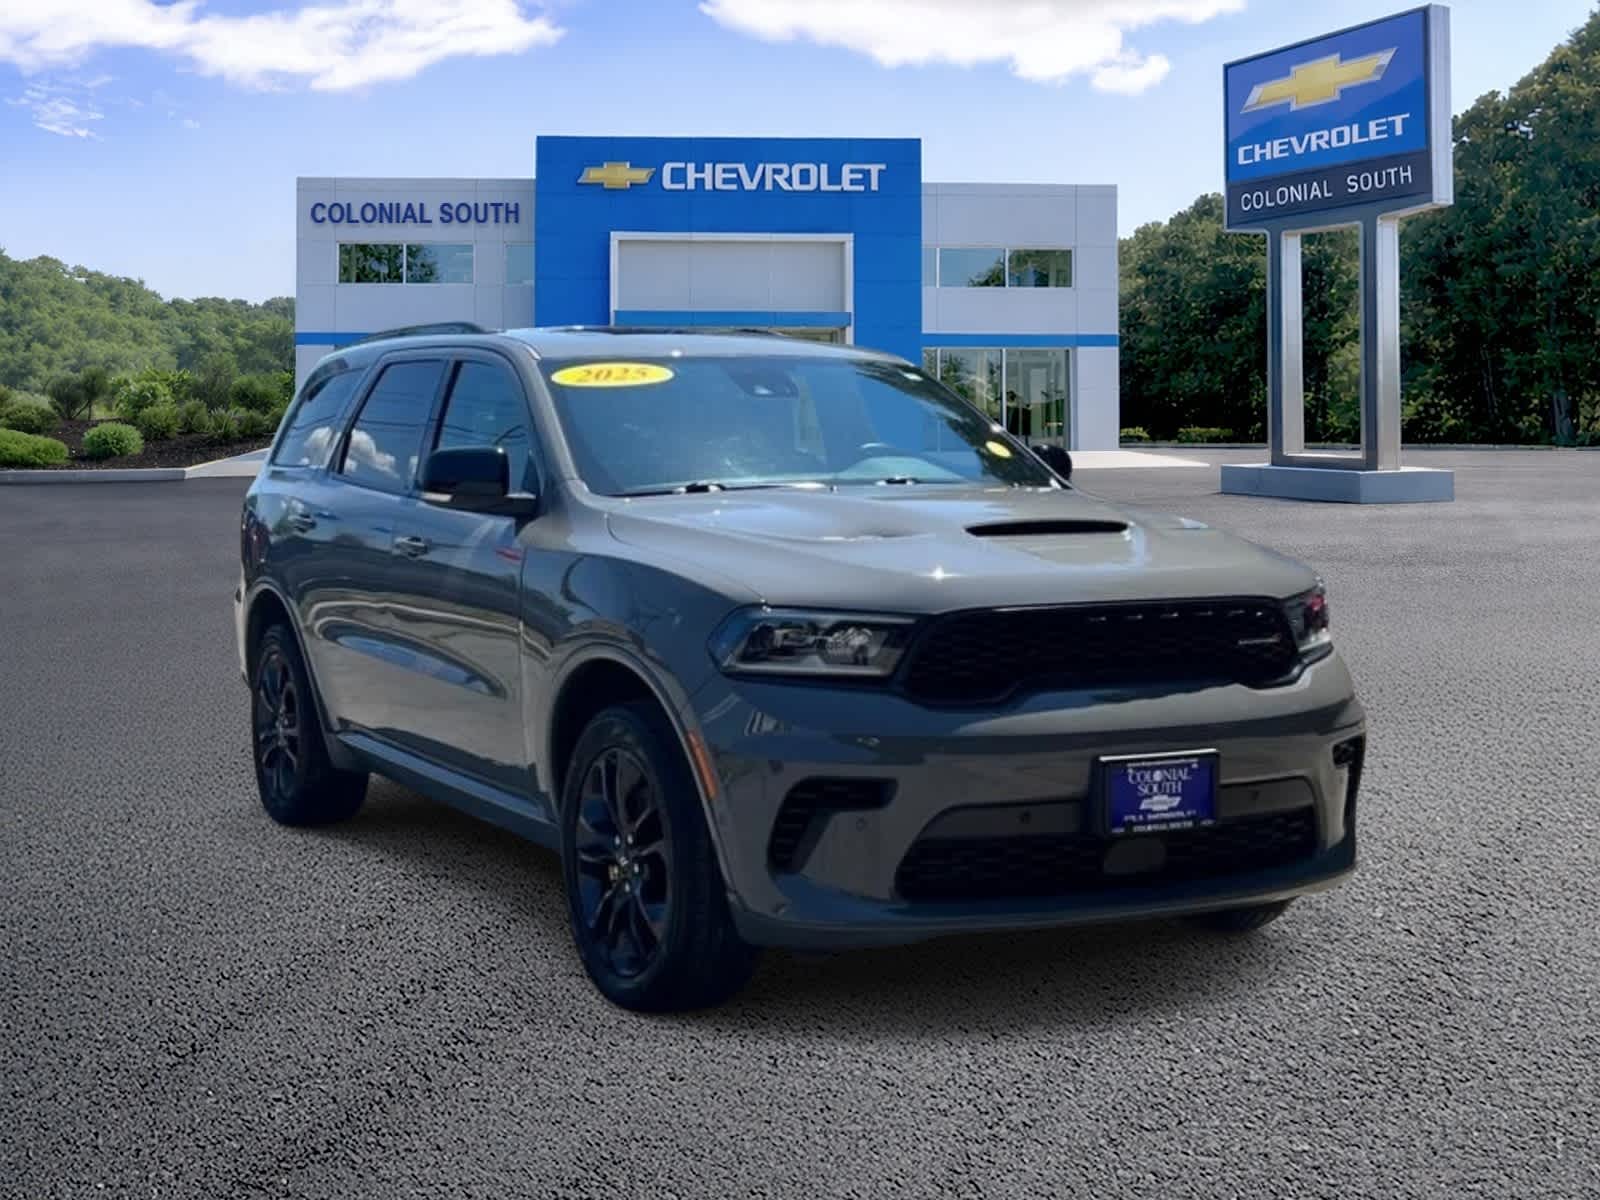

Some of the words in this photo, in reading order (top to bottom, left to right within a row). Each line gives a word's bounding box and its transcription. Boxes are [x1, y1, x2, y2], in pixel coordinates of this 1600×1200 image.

[1237, 112, 1411, 166] CHEVROLET
[661, 161, 887, 193] CHEVROLET
[1240, 179, 1334, 212] COLONIAL
[1346, 165, 1413, 194] SOUTH
[310, 201, 433, 225] COLONIAL
[438, 201, 521, 225] SOUTH
[576, 367, 649, 383] 2025
[1137, 780, 1183, 797] SOUTH
